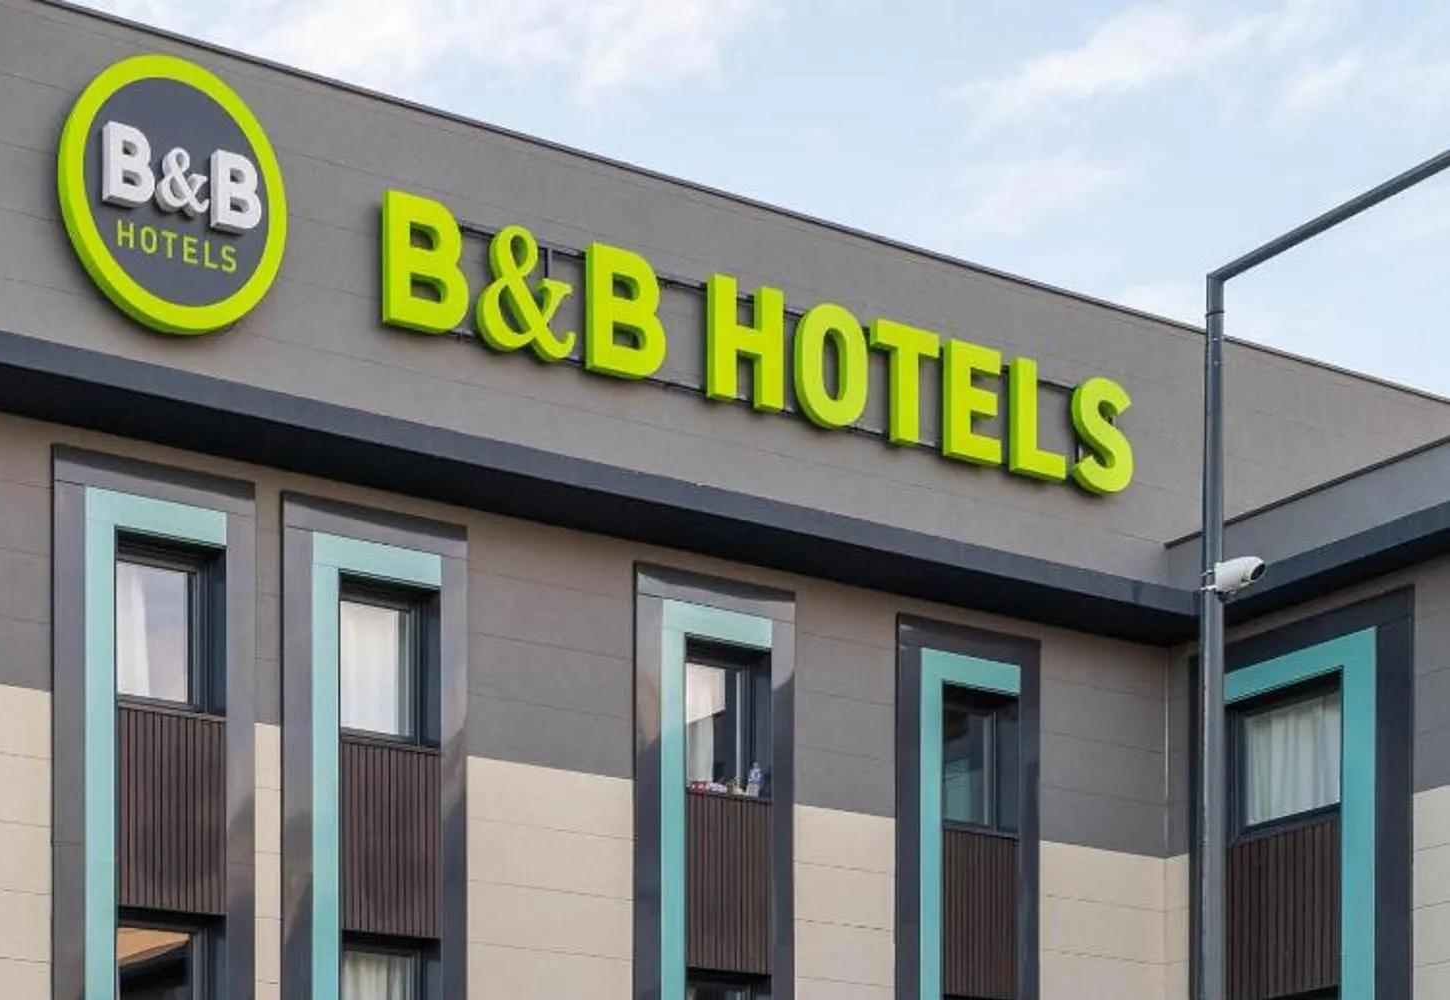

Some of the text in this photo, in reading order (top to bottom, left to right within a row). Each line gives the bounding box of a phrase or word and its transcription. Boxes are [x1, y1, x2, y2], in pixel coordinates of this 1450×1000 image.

[102, 121, 262, 229] B&B
[117, 219, 238, 273] HOTELS
[381, 189, 1134, 496] B&B HOTELS
